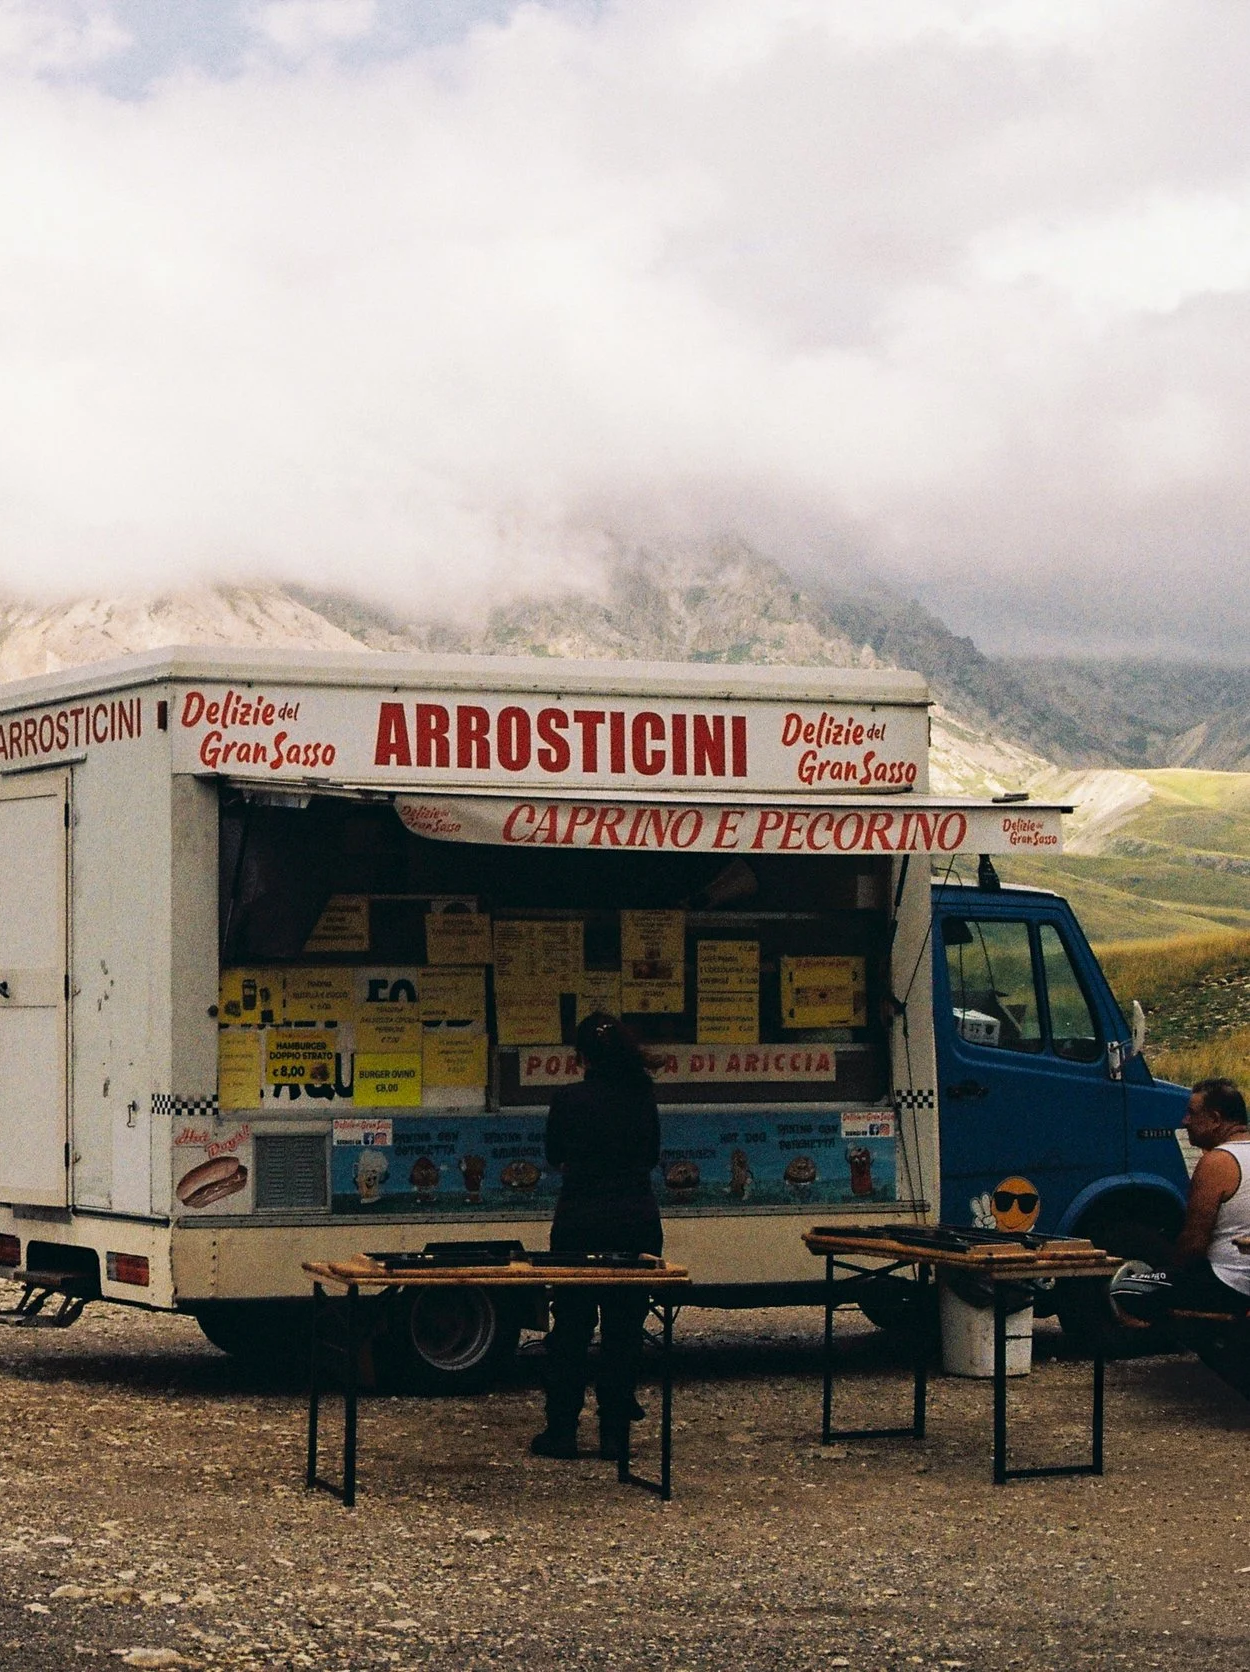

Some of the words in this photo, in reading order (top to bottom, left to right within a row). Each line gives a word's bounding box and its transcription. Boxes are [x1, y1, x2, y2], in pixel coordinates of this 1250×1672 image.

[181, 690, 276, 728] Delizie
[278, 702, 300, 721] del
[781, 711, 865, 748] Delizie
[866, 723, 886, 741] del
[374, 702, 748, 778] ARROSTICINI
[503, 803, 704, 849] CAPRINO
[711, 811, 741, 850] E
[750, 811, 968, 852] PECORINO
[1002, 818, 1036, 832] Delizie
[269, 1052, 301, 1060] DOPPIO
[302, 1052, 333, 1060] STRATO
[276, 1042, 327, 1050] HAMBURGER
[690, 1054, 716, 1073] DI
[724, 1053, 831, 1073] ARICCIA
[359, 1070, 390, 1079] BURGER
[391, 1070, 416, 1078] OVINO
